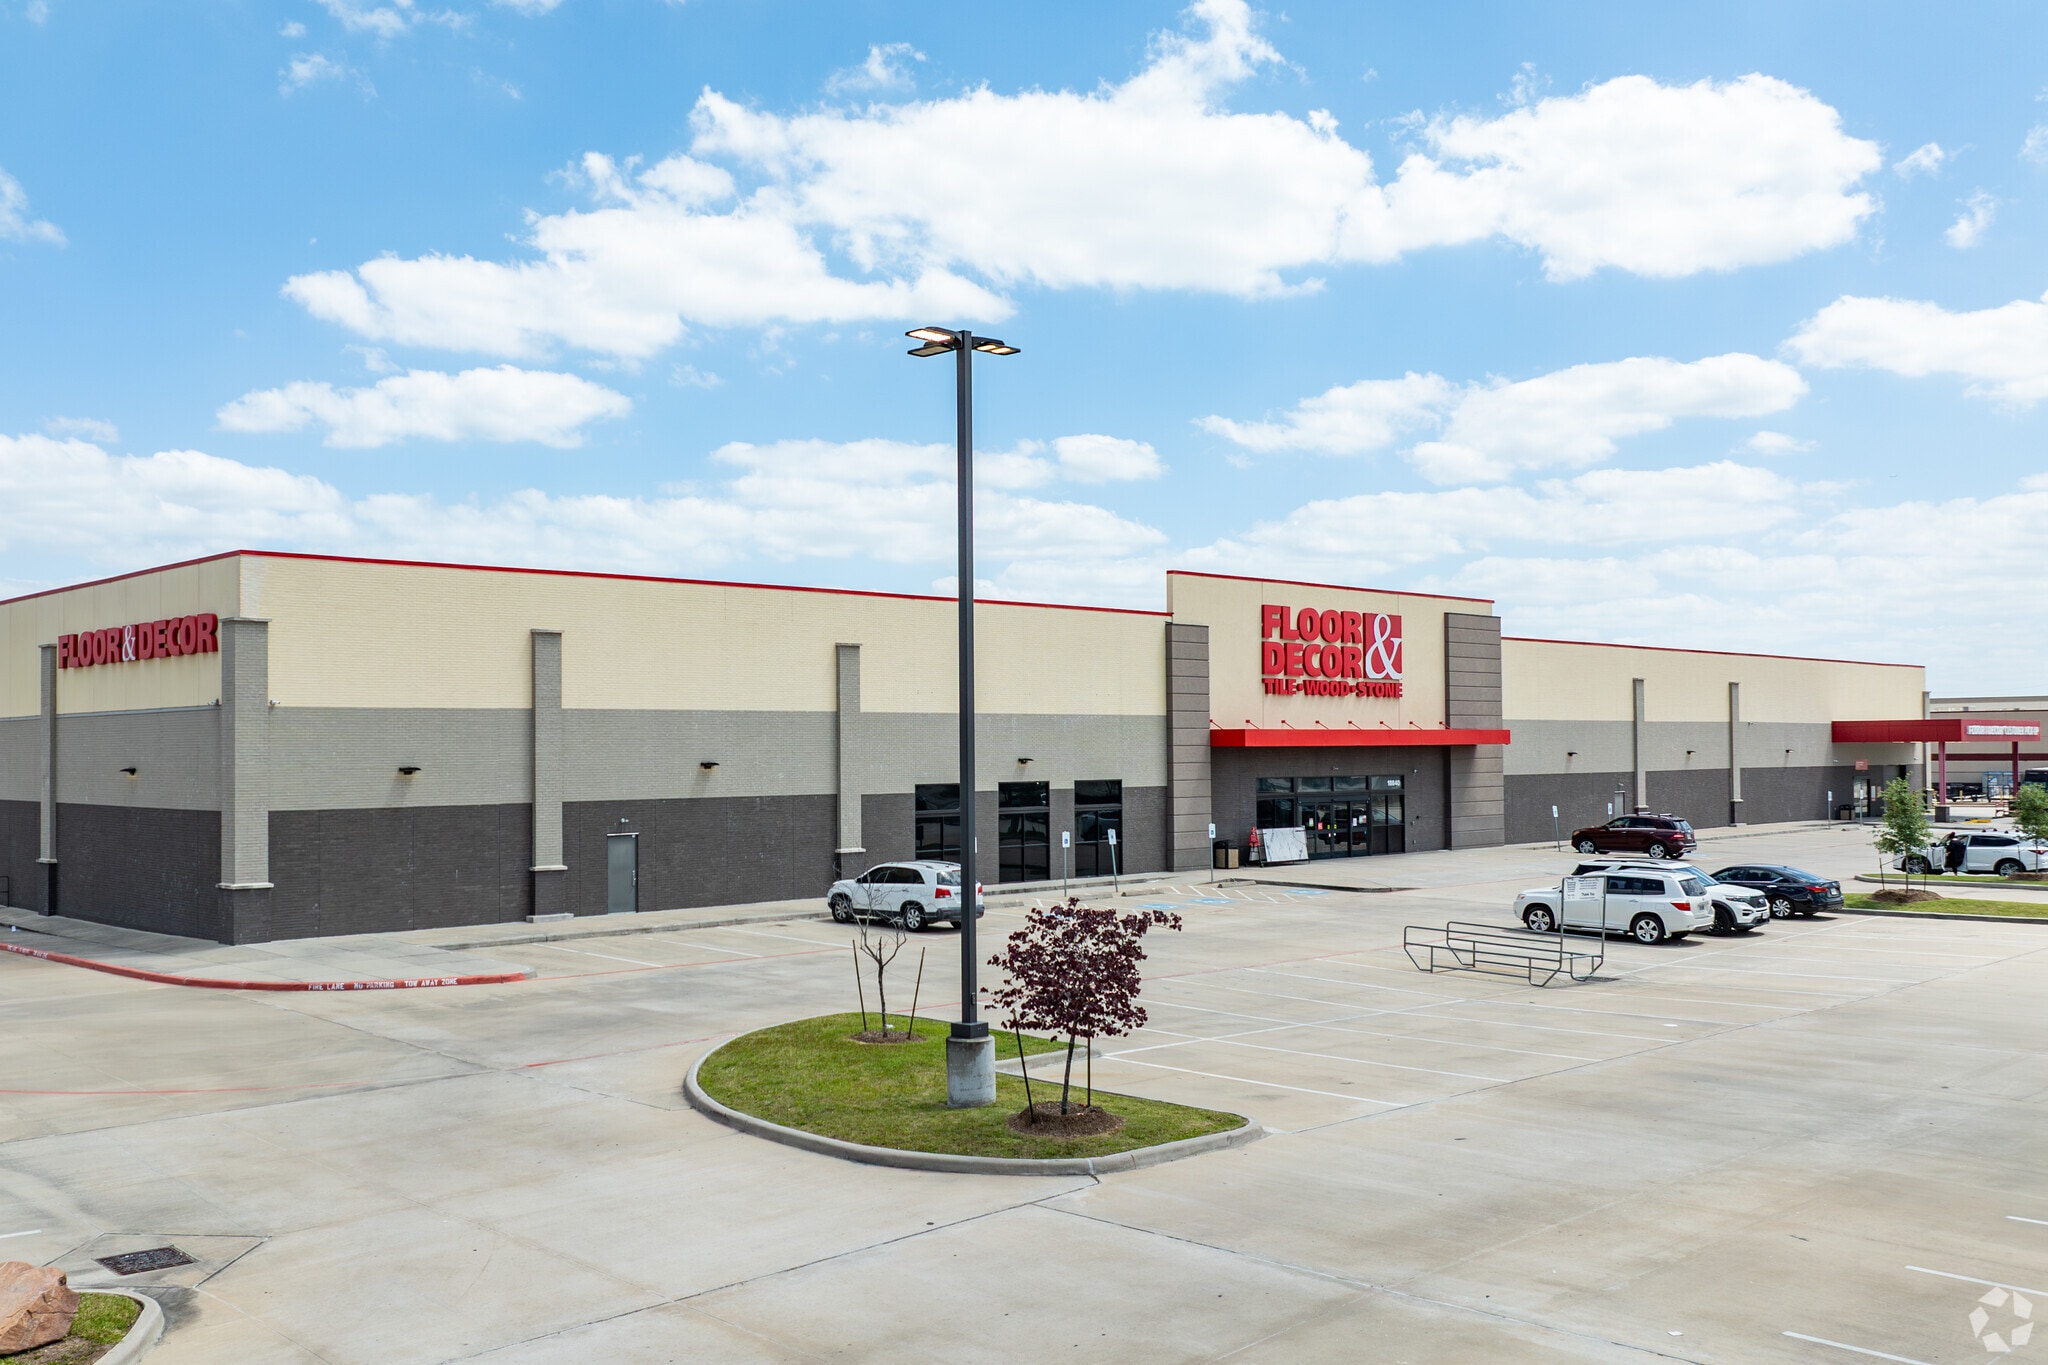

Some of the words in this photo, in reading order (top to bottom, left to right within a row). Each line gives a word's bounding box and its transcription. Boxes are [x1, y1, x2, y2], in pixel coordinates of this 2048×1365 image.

[58, 627, 122, 669] FLOOR
[137, 613, 218, 660] DECOR
[1262, 604, 1362, 643] FLOOR
[1363, 612, 1403, 680] &
[1262, 641, 1362, 679] DECOR
[1262, 678, 1297, 695] TILE
[1303, 680, 1351, 697] WOOD
[1356, 682, 1403, 698] STONE
[326, 982, 345, 991] LANE
[366, 981, 395, 989] PARKING
[420, 979, 439, 987] AWAY
[441, 977, 458, 985] ZONE
